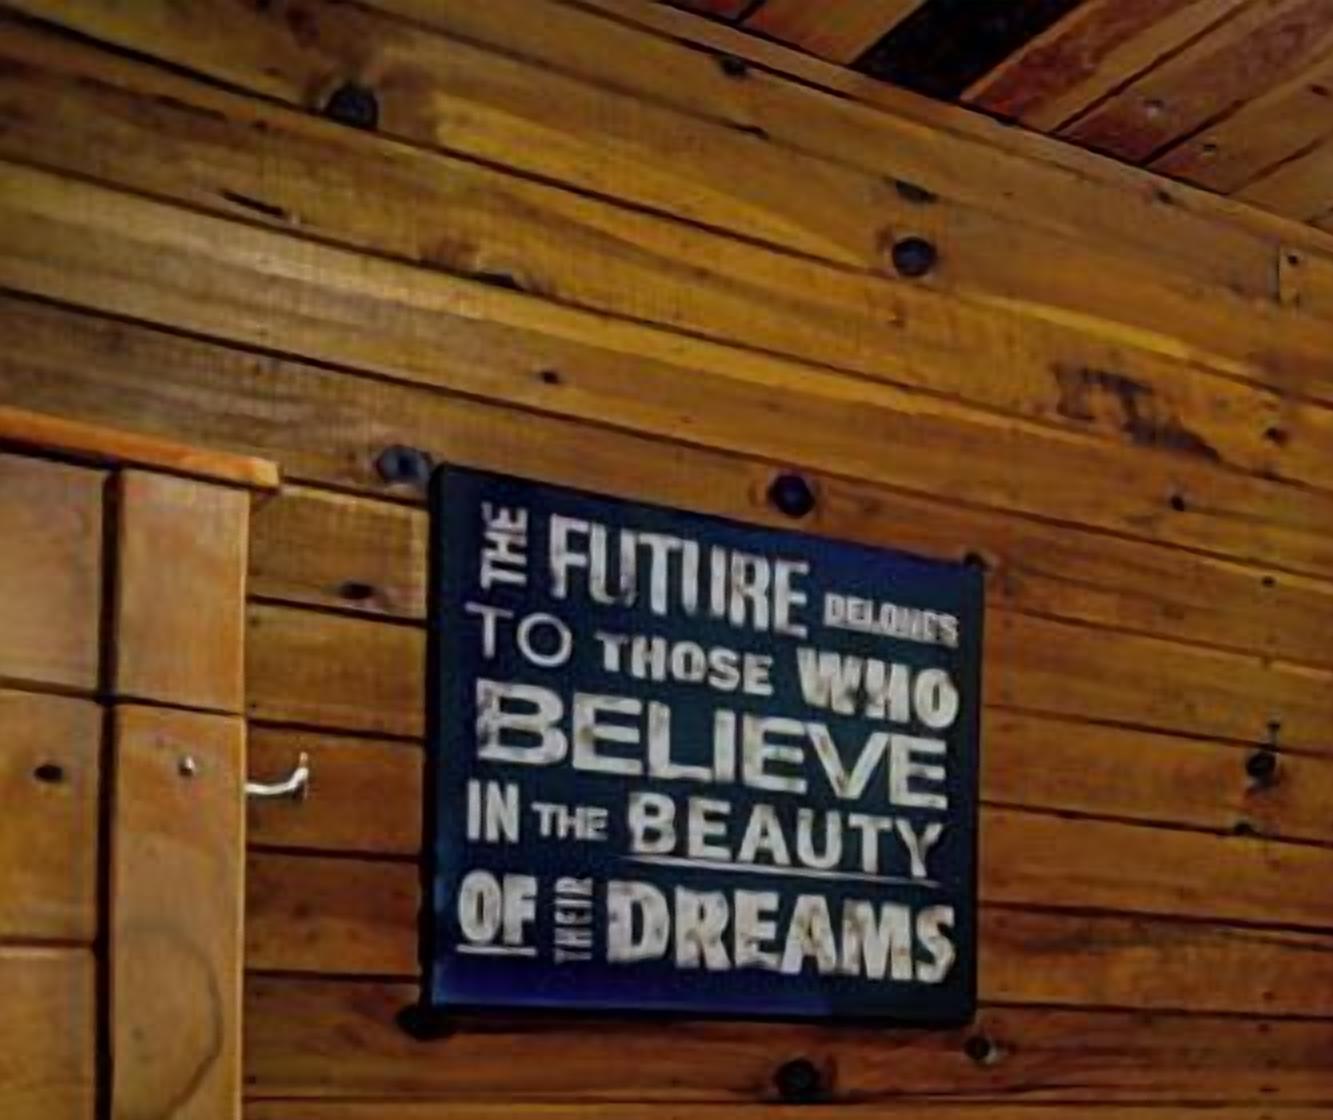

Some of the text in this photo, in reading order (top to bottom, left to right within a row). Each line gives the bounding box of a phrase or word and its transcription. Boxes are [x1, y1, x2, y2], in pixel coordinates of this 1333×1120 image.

[478, 501, 528, 589] THE
[549, 512, 810, 638] FUTURE
[465, 602, 960, 730] TO THOSE WHO
[476, 677, 947, 811] BELIEVE
[467, 780, 943, 879] IN THE BEAUTY
[457, 870, 538, 944] OF
[606, 880, 956, 984] DREAMS
